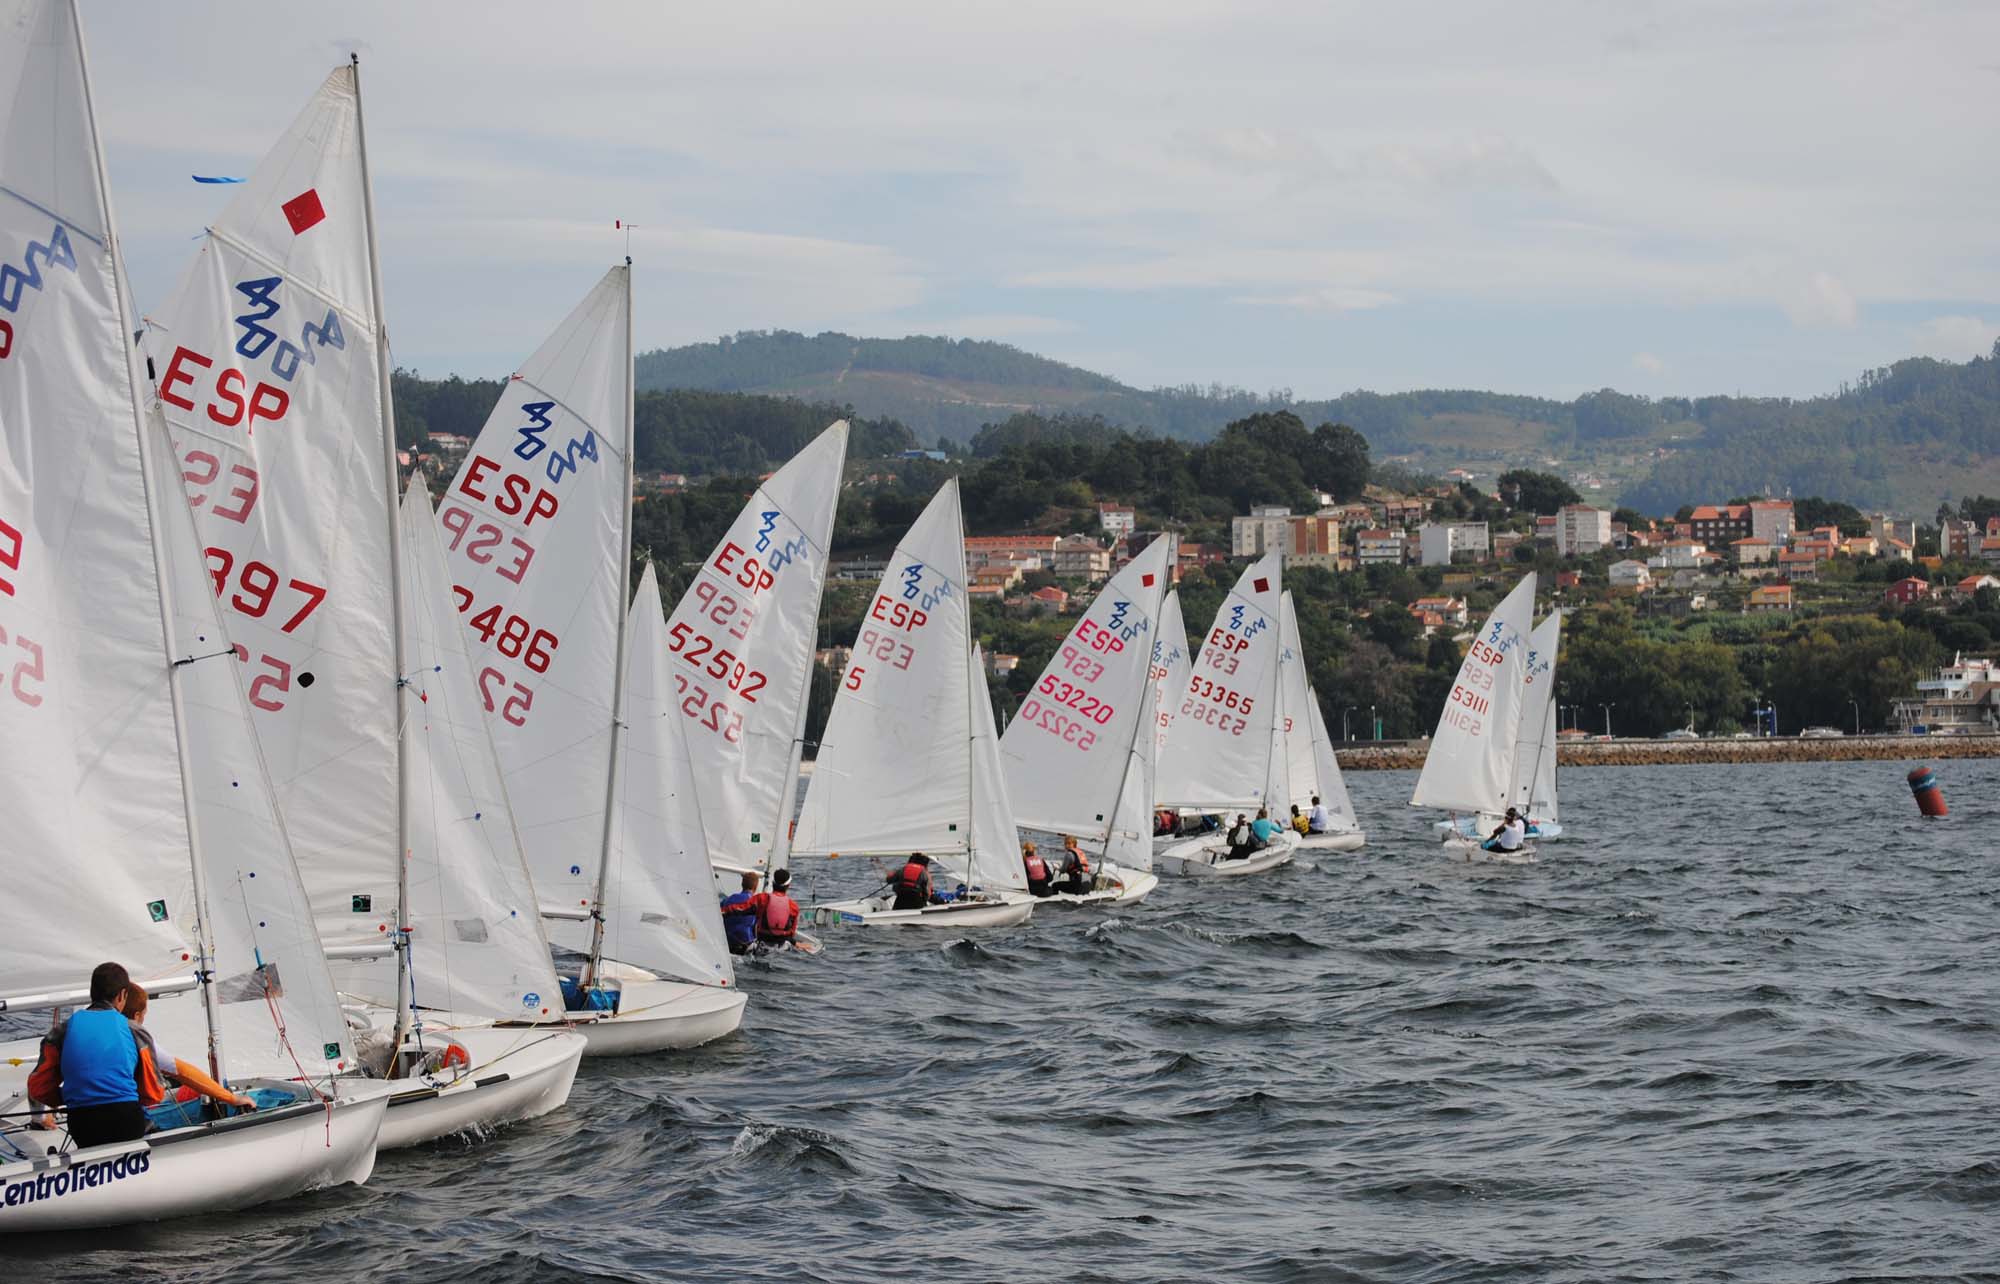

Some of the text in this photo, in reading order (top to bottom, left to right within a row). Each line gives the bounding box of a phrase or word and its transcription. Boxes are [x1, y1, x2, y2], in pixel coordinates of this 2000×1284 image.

[235, 276, 283, 359] 420
[159, 345, 289, 436] ESP
[513, 401, 556, 461] 420
[459, 455, 559, 527] ESP
[755, 511, 780, 553] 420
[713, 542, 774, 595] ESP
[903, 564, 924, 600] 420
[871, 595, 928, 632] ESP
[1108, 601, 1131, 630] 420
[1230, 605, 1245, 630] 420
[1075, 618, 1125, 655] ESP
[1209, 627, 1249, 655] ESP
[1471, 640, 1504, 667] ESP
[668, 622, 768, 703] 52592
[846, 666, 865, 691] 5
[1039, 673, 1114, 725] 53220
[1190, 675, 1255, 716] 53365
[1451, 685, 1489, 716] 53111
